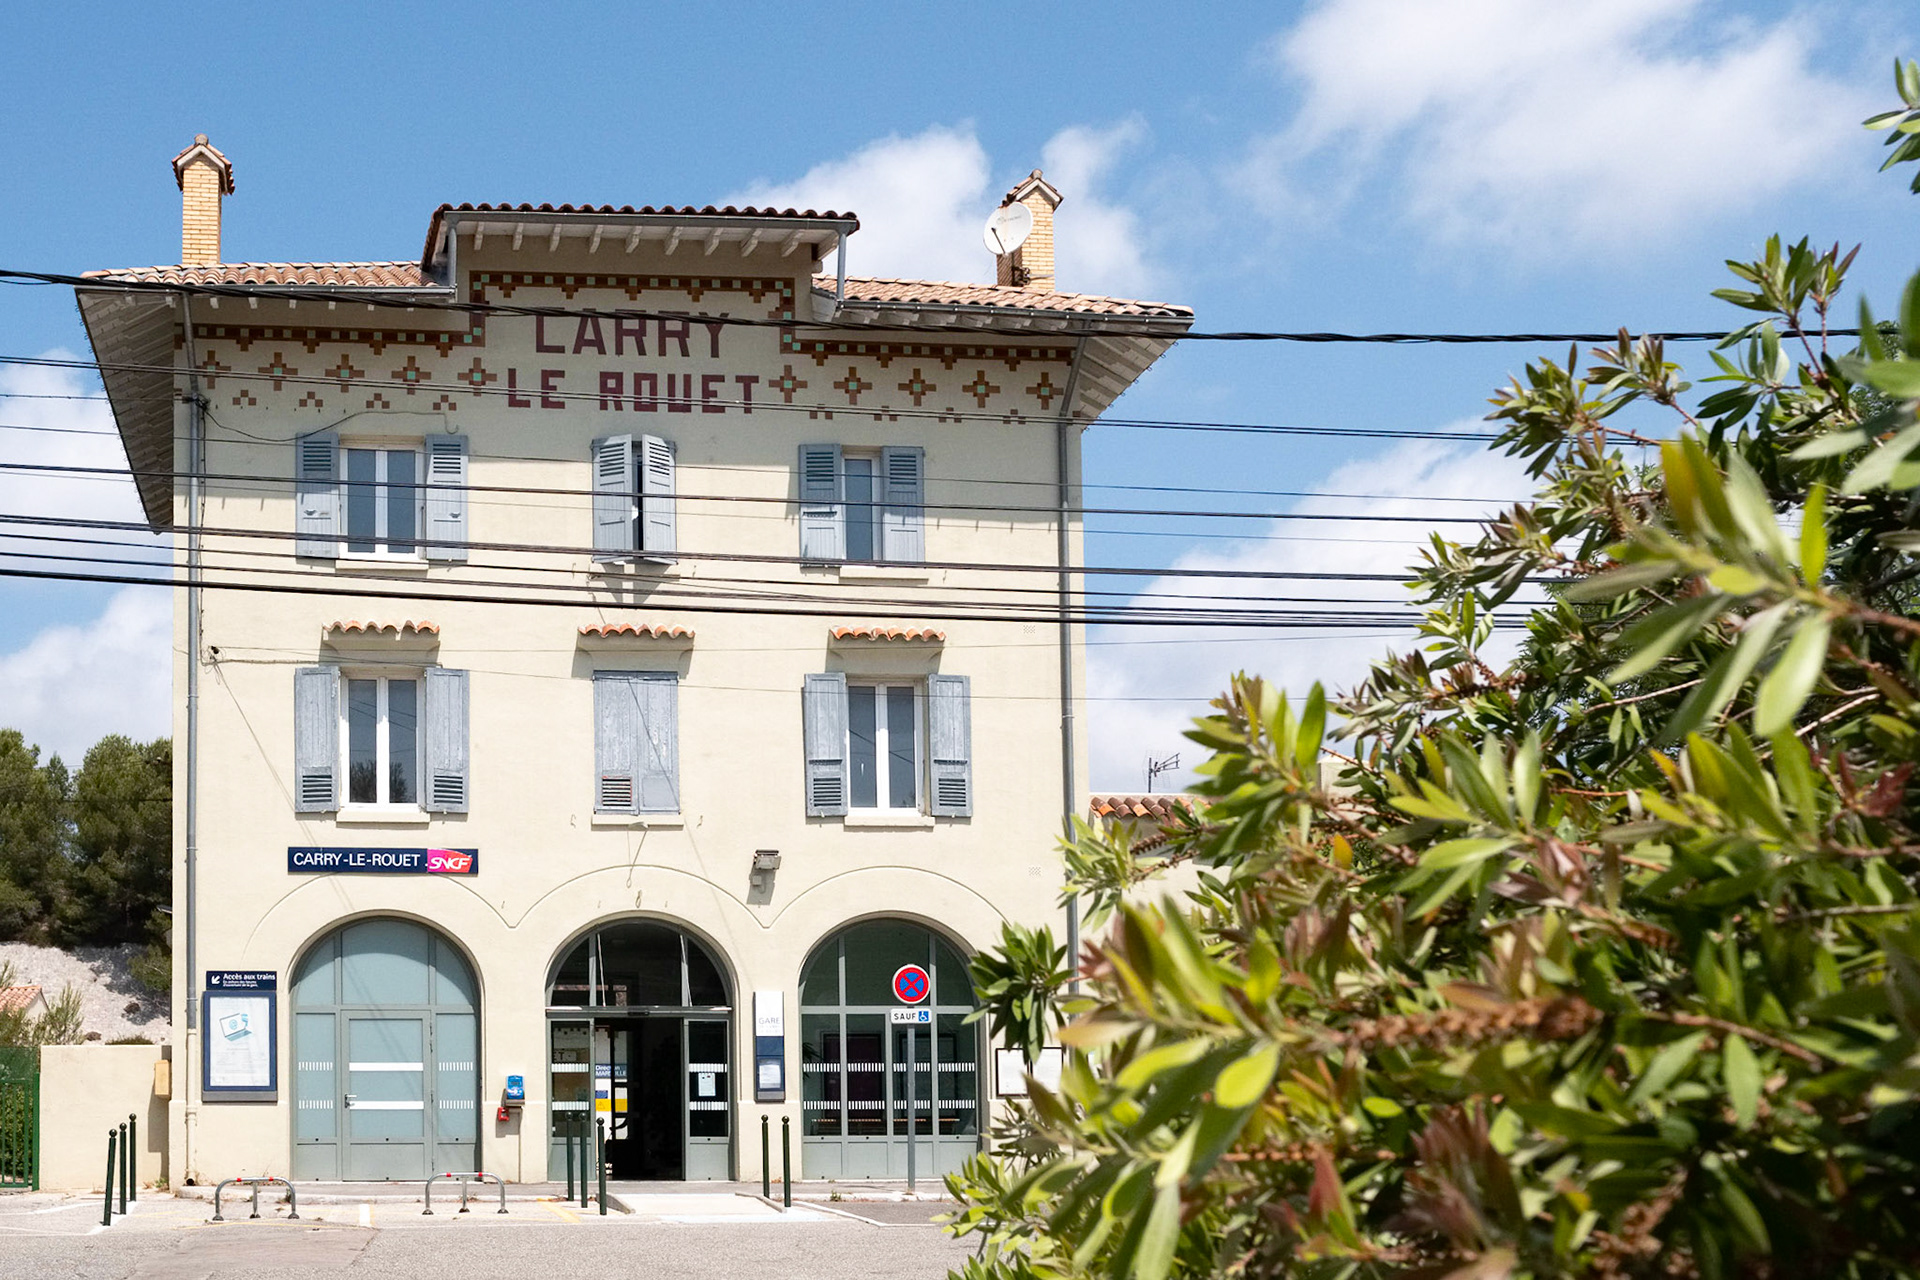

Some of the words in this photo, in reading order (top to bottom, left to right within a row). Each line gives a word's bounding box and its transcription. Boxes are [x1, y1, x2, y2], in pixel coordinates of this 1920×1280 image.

[535, 307, 730, 358] CARRY
[508, 368, 566, 409] LE
[599, 371, 760, 414] ROUET
[293, 852, 421, 867] CARRY-LE-ROUET
[429, 856, 470, 870] SNCF
[758, 1017, 780, 1025] GARE
[893, 1012, 916, 1020] SAUF
